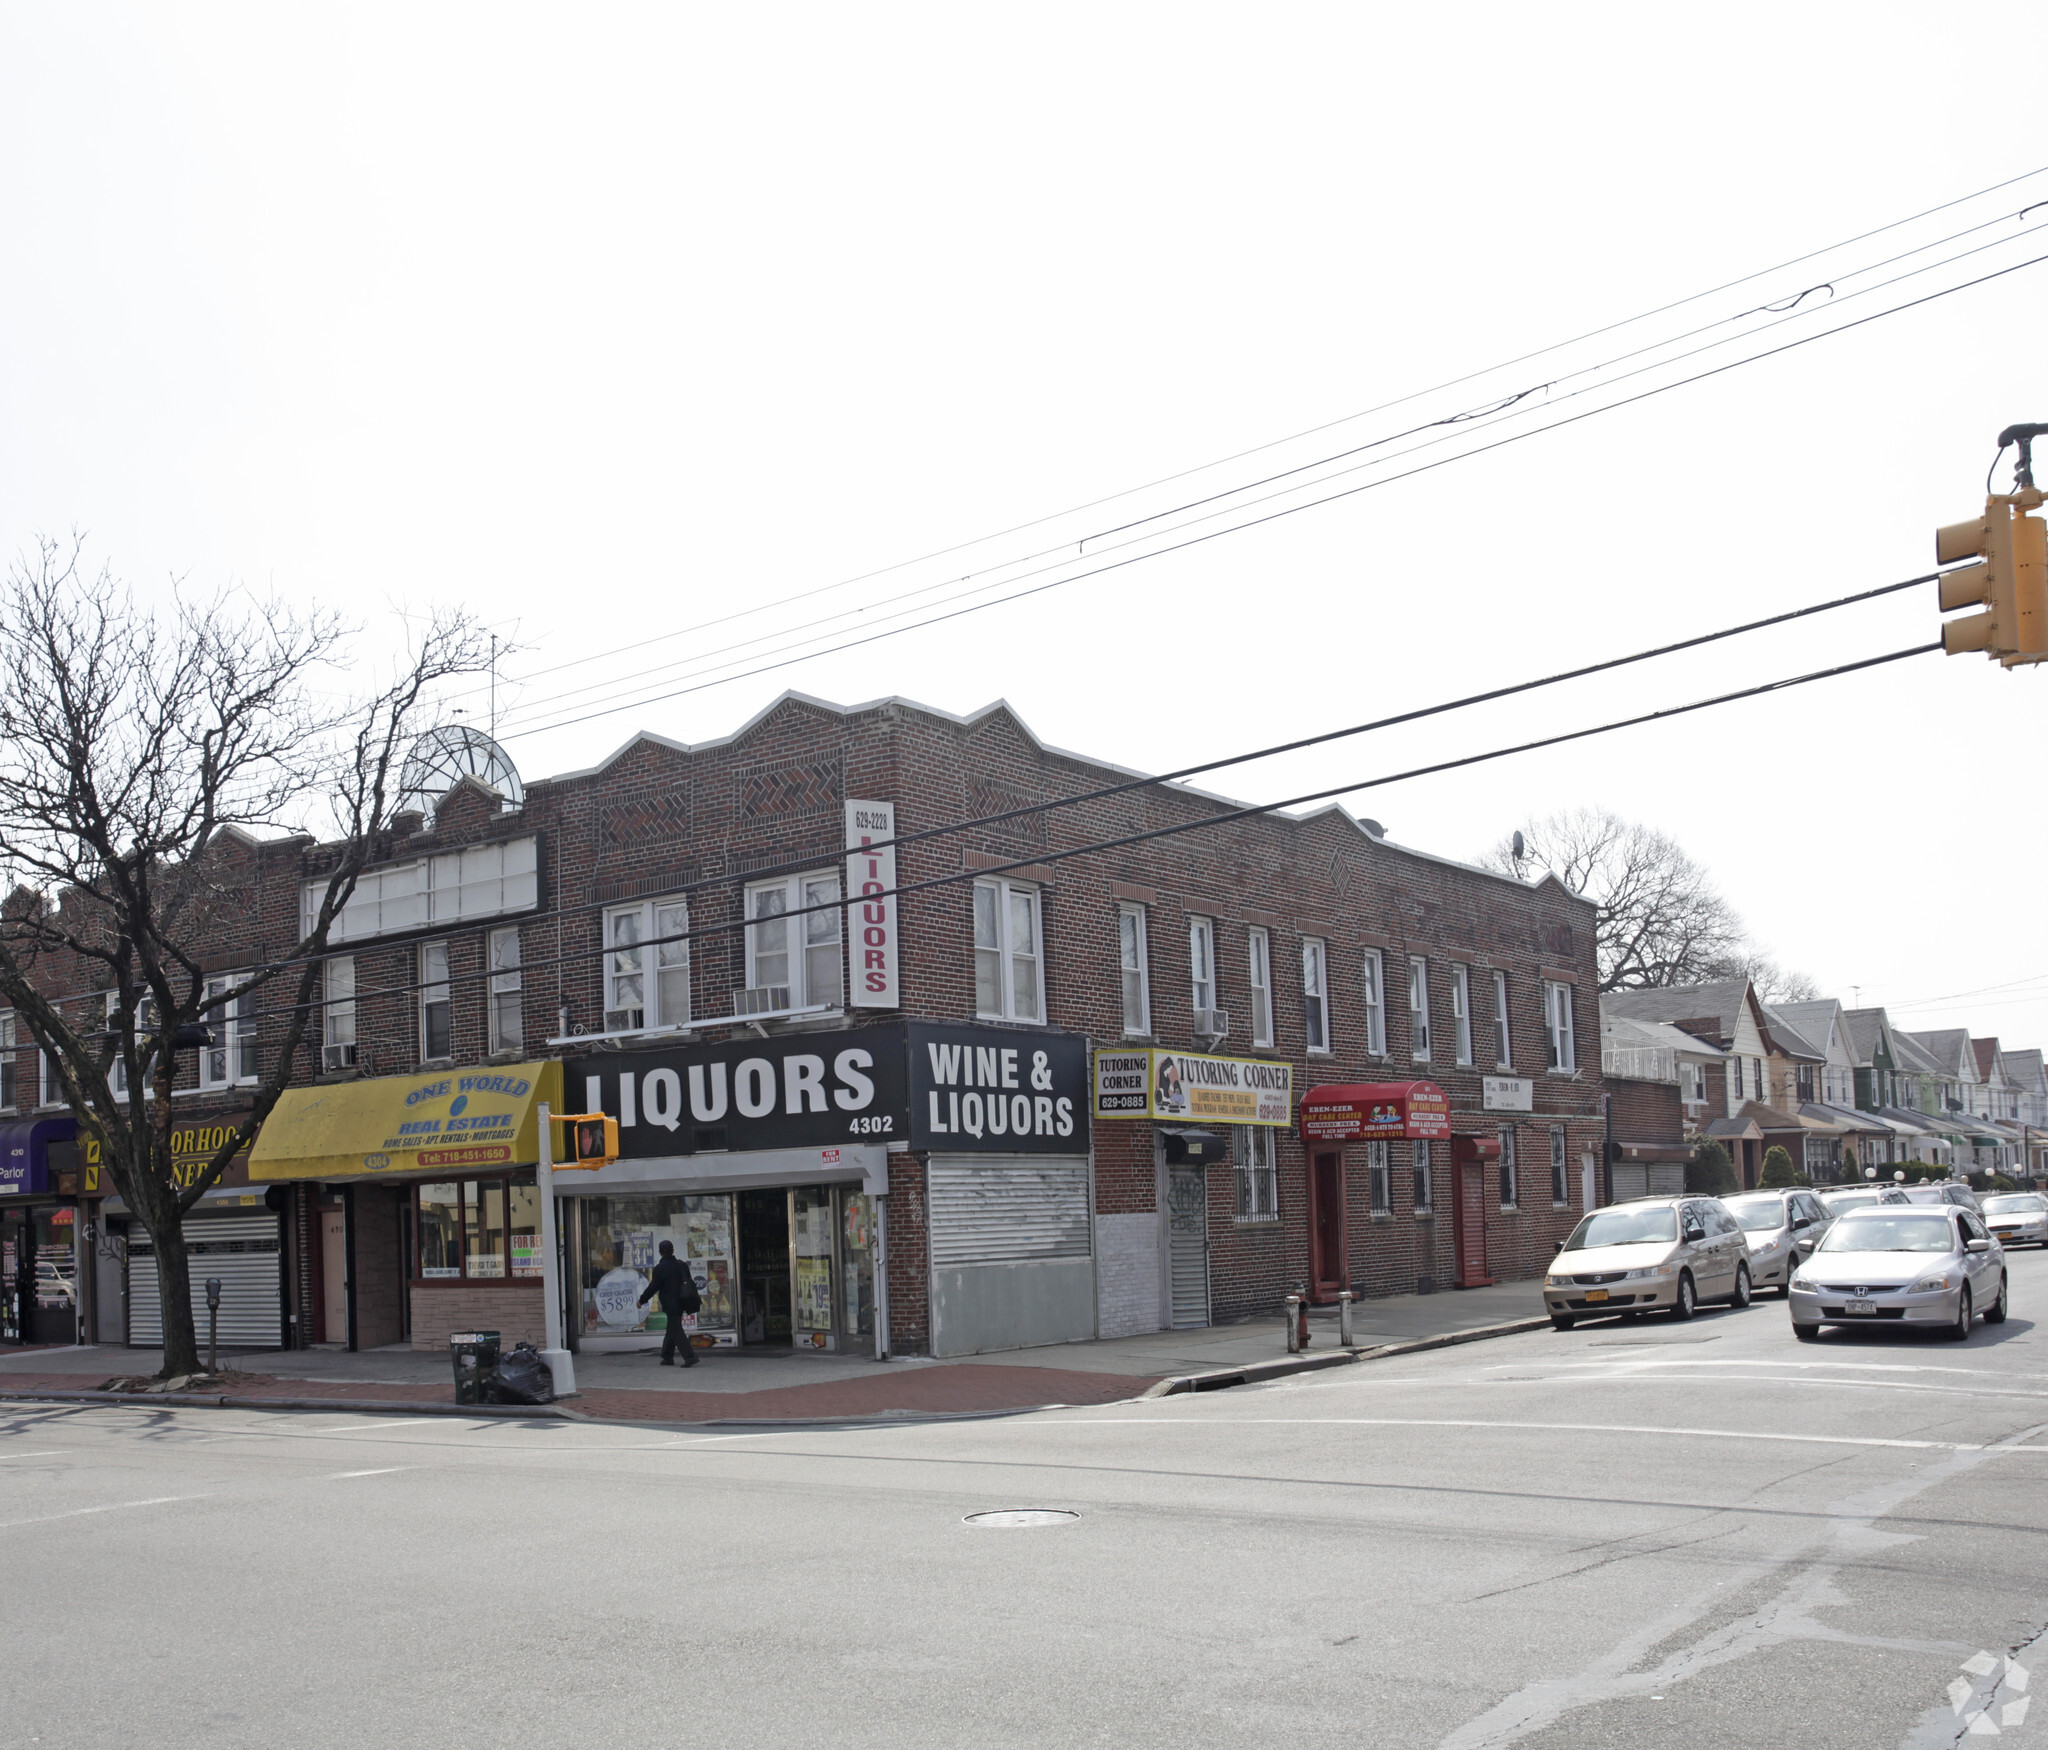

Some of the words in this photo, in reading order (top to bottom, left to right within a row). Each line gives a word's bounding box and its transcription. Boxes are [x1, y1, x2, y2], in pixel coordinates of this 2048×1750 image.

[856, 811, 887, 831] 629-2228
[861, 836, 887, 993] LIQUORS
[928, 1042, 1019, 1089] WINE
[1030, 1050, 1053, 1090] &
[1100, 1058, 1146, 1072] TUTORING
[1177, 1057, 1239, 1086] TUTORING
[1243, 1066, 1289, 1090] CORNER
[404, 1079, 452, 1107] ONE
[458, 1075, 531, 1098] WORLD
[586, 1048, 875, 1133] LIQUORS
[1103, 1075, 1142, 1089] CORNER
[1102, 1096, 1144, 1108] 629-0885
[1413, 1093, 1443, 1102] EBEN-EZER
[929, 1091, 1074, 1140] LIQUORS
[1259, 1104, 1287, 1120] 629-0885
[1309, 1105, 1353, 1113] EBEN-EZER
[398, 1120, 442, 1135] REAL
[446, 1113, 513, 1131] ESTATE
[849, 1115, 893, 1134] 4302
[170, 1125, 251, 1154] ORHOO
[383, 1138, 403, 1148] HOME
[402, 1137, 422, 1147] SALES
[439, 1133, 469, 1144] RENTALS
[471, 1129, 515, 1141] MORTGAGES
[367, 1155, 387, 1167] 4304
[424, 1153, 441, 1163] Tel:
[443, 1148, 504, 1162] 718-451-1650
[823, 1155, 839, 1163] RENT
[513, 1236, 528, 1248] FOR
